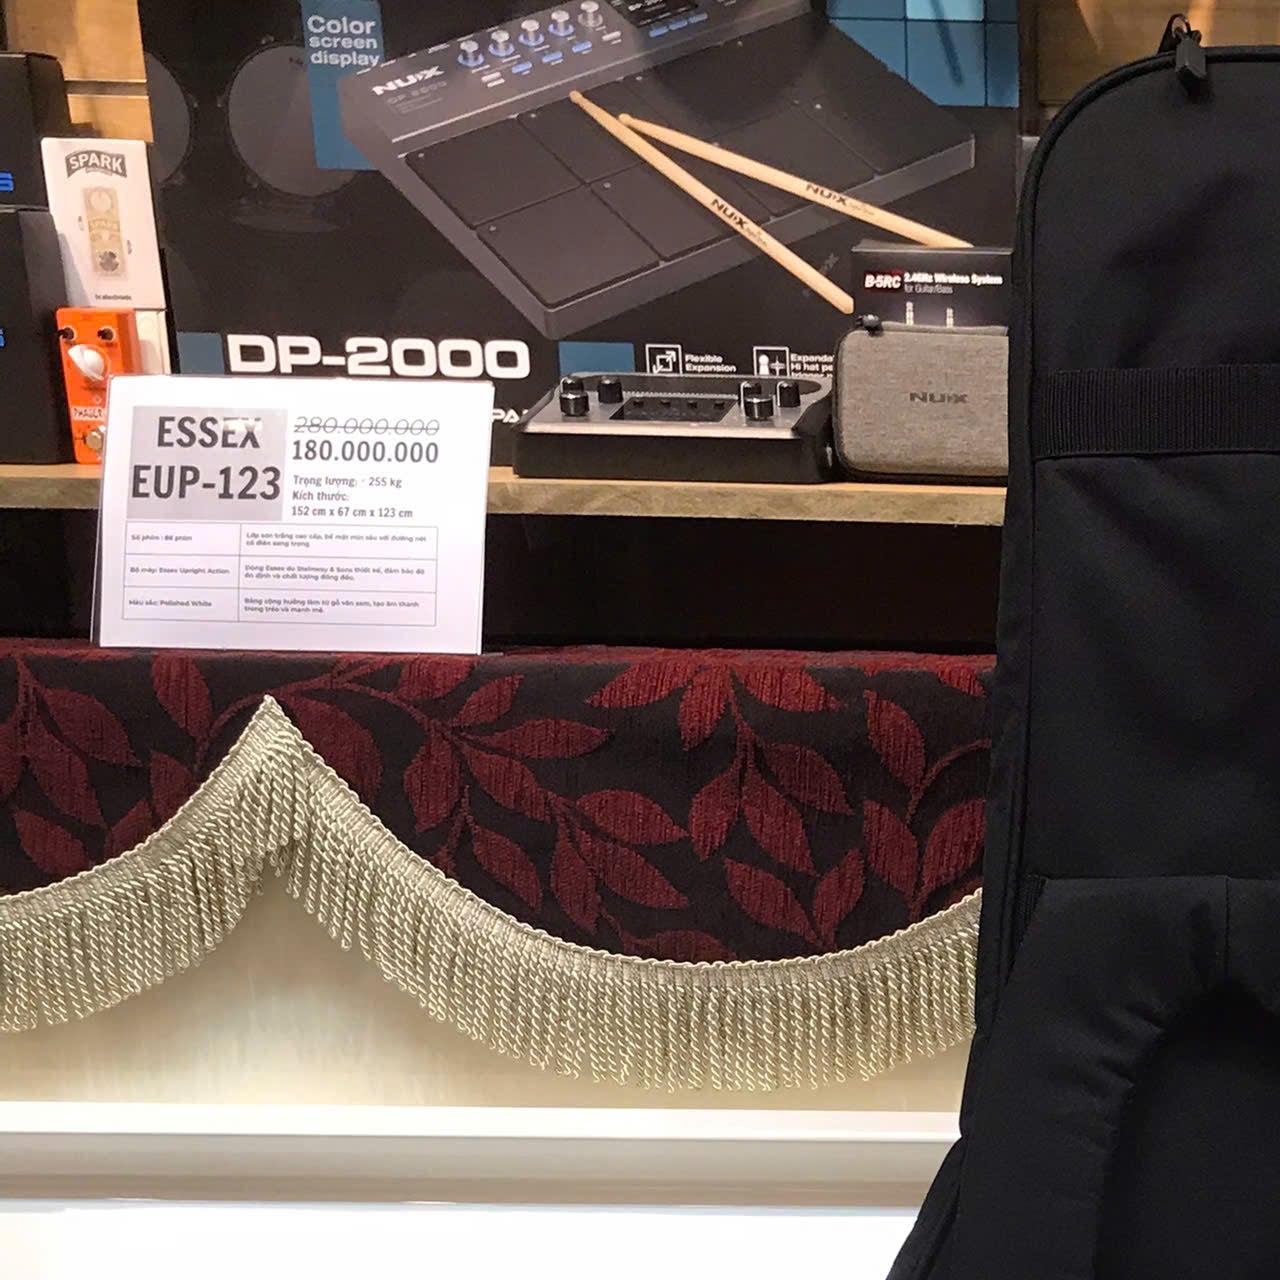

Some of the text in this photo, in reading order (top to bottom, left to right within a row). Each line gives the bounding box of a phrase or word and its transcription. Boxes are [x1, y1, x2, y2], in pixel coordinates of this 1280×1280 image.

[307, 15, 376, 34] Color
[309, 36, 378, 49] screen
[310, 50, 380, 68] display
[69, 152, 123, 173] SPARK
[934, 273, 969, 284] Wireless
[971, 273, 1003, 286] System
[226, 334, 530, 379] DP-2000
[685, 354, 723, 364] Flexible
[790, 353, 834, 362] Expanda
[685, 363, 736, 373] Expansion
[157, 416, 261, 449] ESSEX
[293, 416, 440, 435] 280.000.000
[292, 439, 439, 464] 180.000.000
[131, 464, 281, 500] EUP-123
[292, 475, 322, 487] Trọng
[368, 476, 387, 487] 255
[389, 477, 402, 489] kg
[292, 489, 314, 501] Kích
[291, 506, 309, 517] 152
[311, 508, 327, 517] cm
[337, 507, 350, 517] 67
[352, 509, 367, 517] cm
[378, 507, 396, 518] 123
[398, 509, 413, 518] cm
